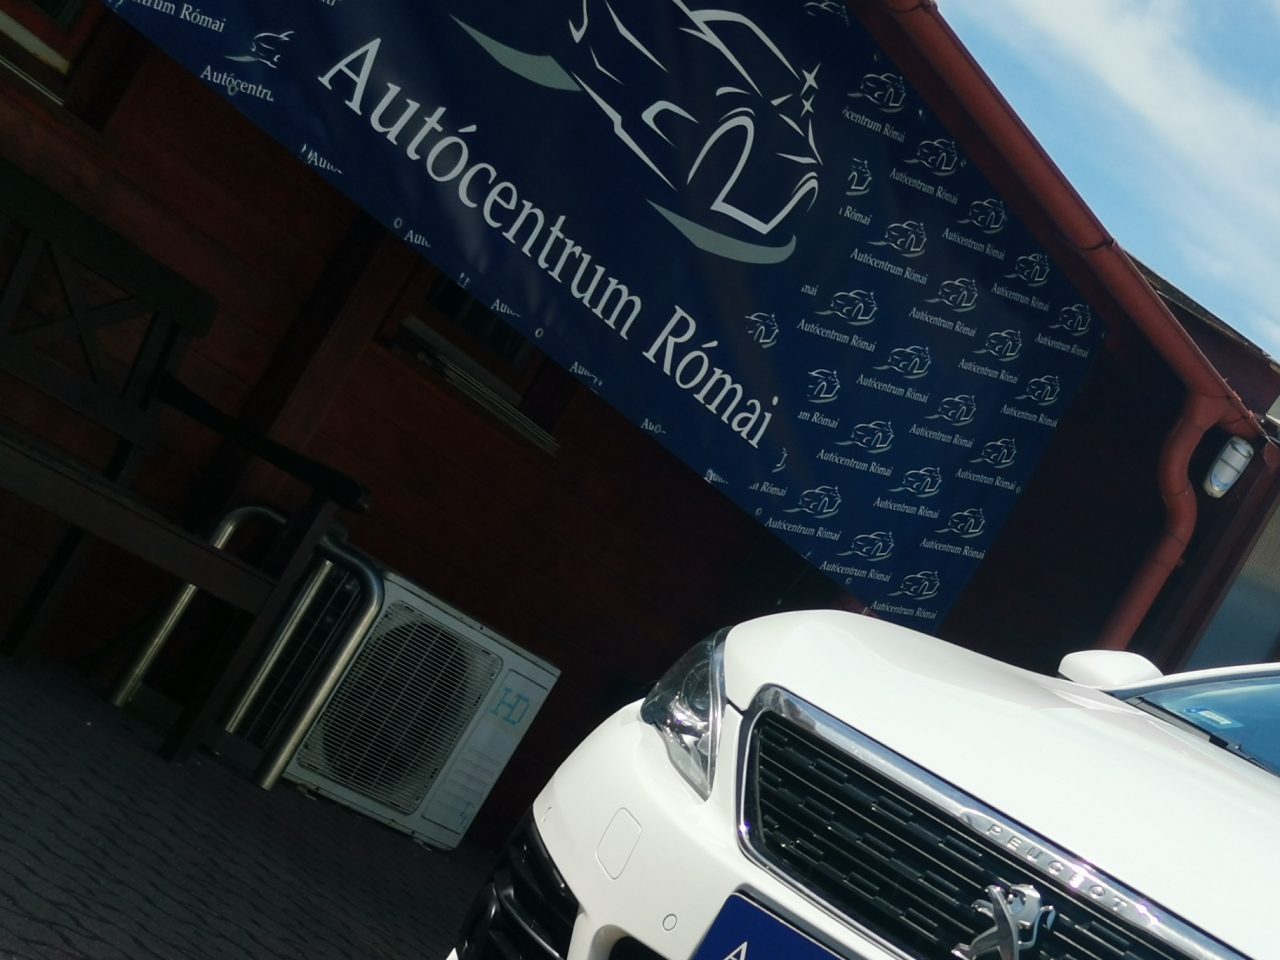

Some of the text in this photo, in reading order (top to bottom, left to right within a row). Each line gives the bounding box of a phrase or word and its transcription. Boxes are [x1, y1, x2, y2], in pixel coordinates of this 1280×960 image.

[180, 3, 227, 32] Római
[843, 205, 873, 226] Római
[318, 37, 780, 448] Autócentrum Római
[850, 247, 929, 285] Autócentrum Római
[796, 318, 878, 352] Autócentrum Római
[856, 373, 931, 403] Autócentrum Római
[811, 411, 840, 429] Római
[816, 448, 894, 477] Autócentrum Római
[765, 516, 842, 541] Autócentrum Római
[984, 823, 1129, 912] PEUGEOT
